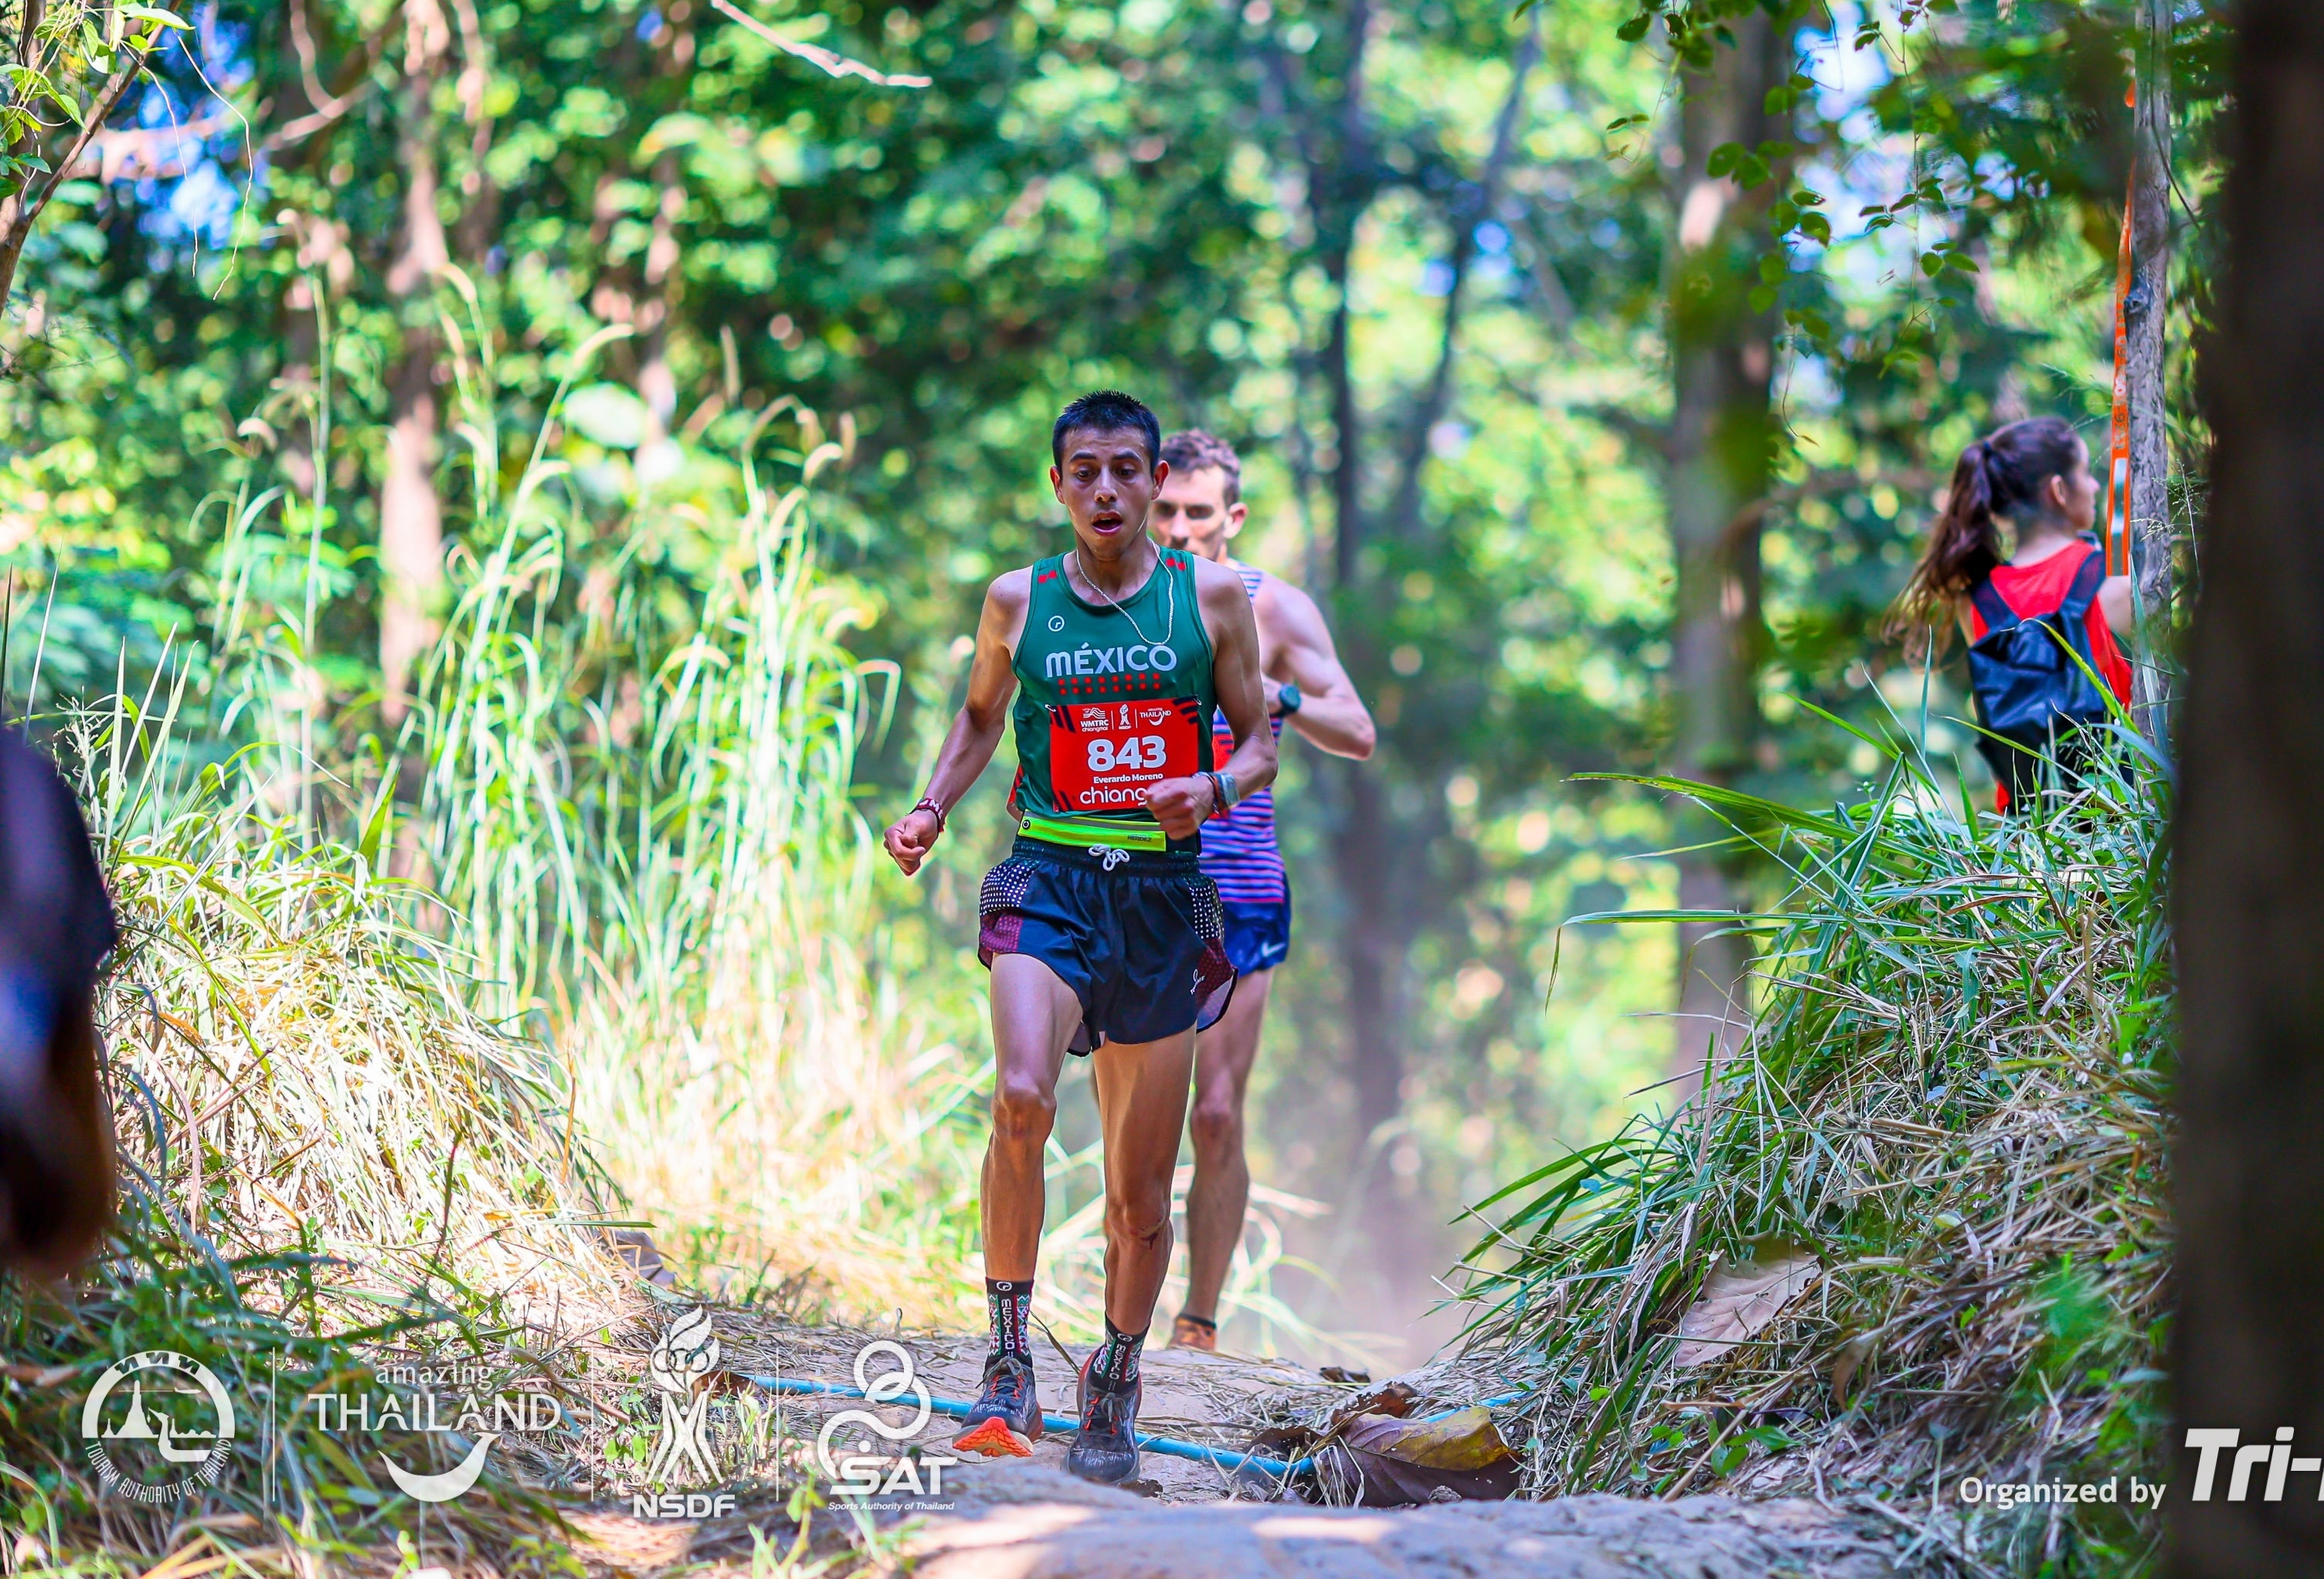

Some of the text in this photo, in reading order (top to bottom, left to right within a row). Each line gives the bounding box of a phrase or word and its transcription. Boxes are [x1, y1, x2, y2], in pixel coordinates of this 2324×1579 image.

[1045, 642, 1177, 678] MÉXICO
[1080, 719, 1109, 728] WMTRC
[1087, 735, 1167, 772] 843
[1093, 773, 1164, 784] Everardo Moreno
[1001, 1298, 1015, 1350] MEXICO
